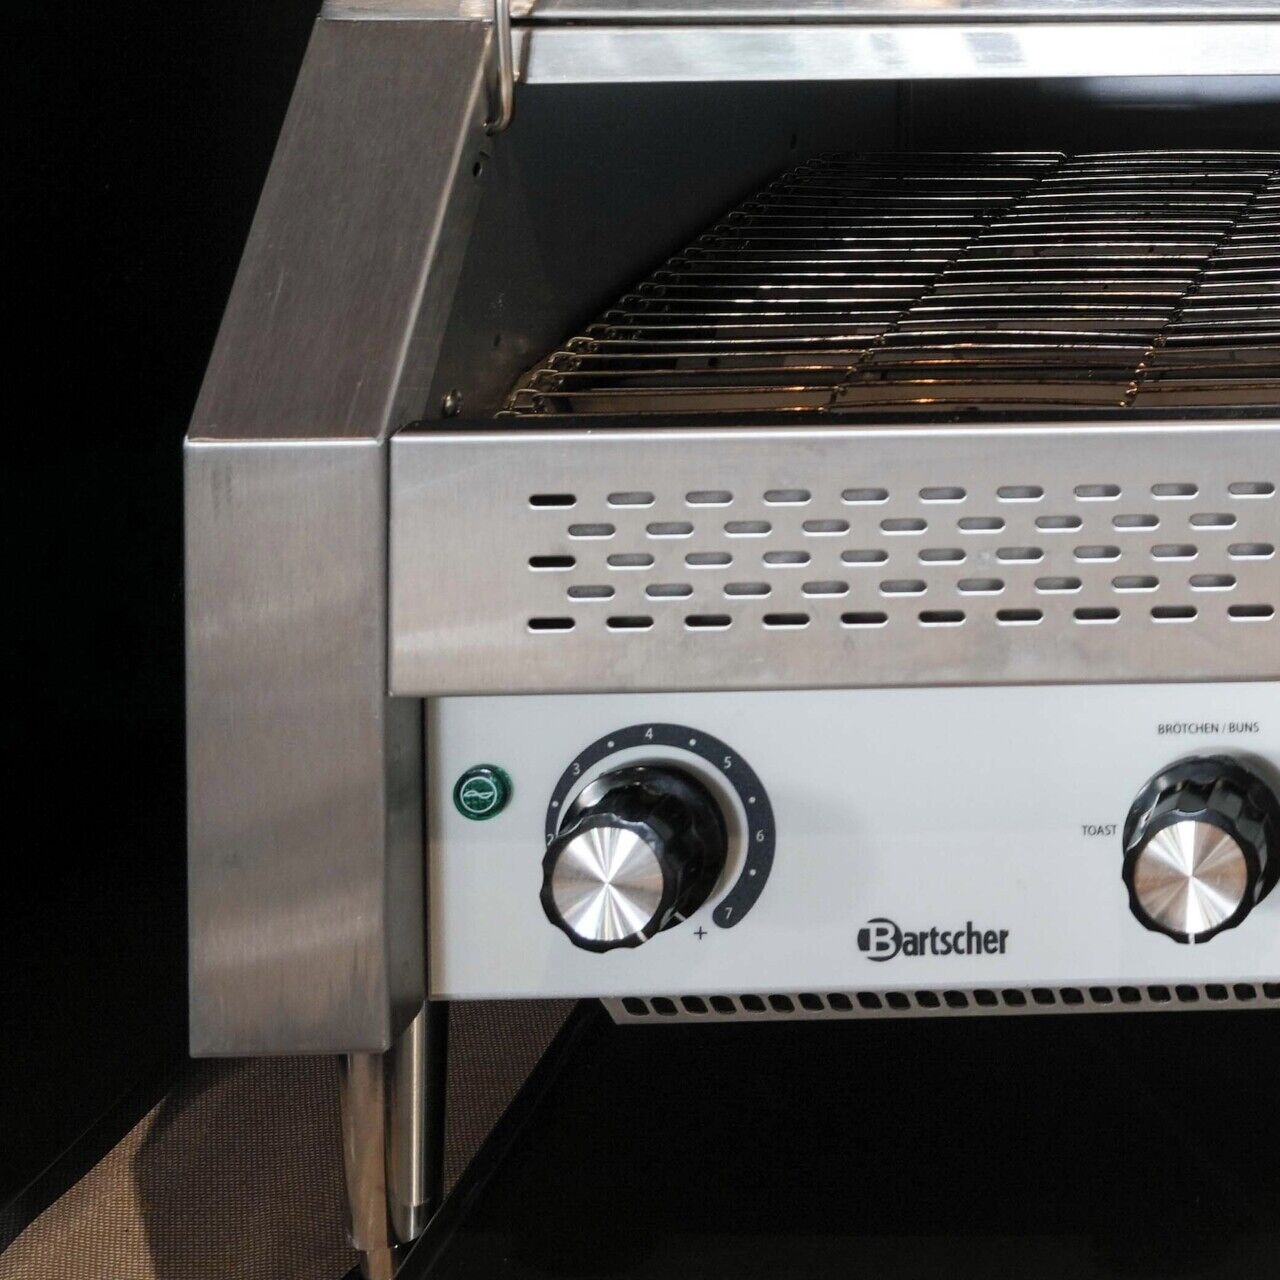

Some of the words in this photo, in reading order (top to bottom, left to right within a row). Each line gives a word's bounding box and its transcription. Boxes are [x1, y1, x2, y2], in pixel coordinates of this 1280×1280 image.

[644, 727, 654, 740] 4
[1228, 721, 1260, 734] BUNS
[573, 762, 581, 776] 3
[724, 756, 732, 769] 5
[756, 829, 765, 842] 6
[1080, 823, 1118, 837] TOAST
[725, 906, 733, 919] 7
[857, 917, 1009, 962] Bartscher
